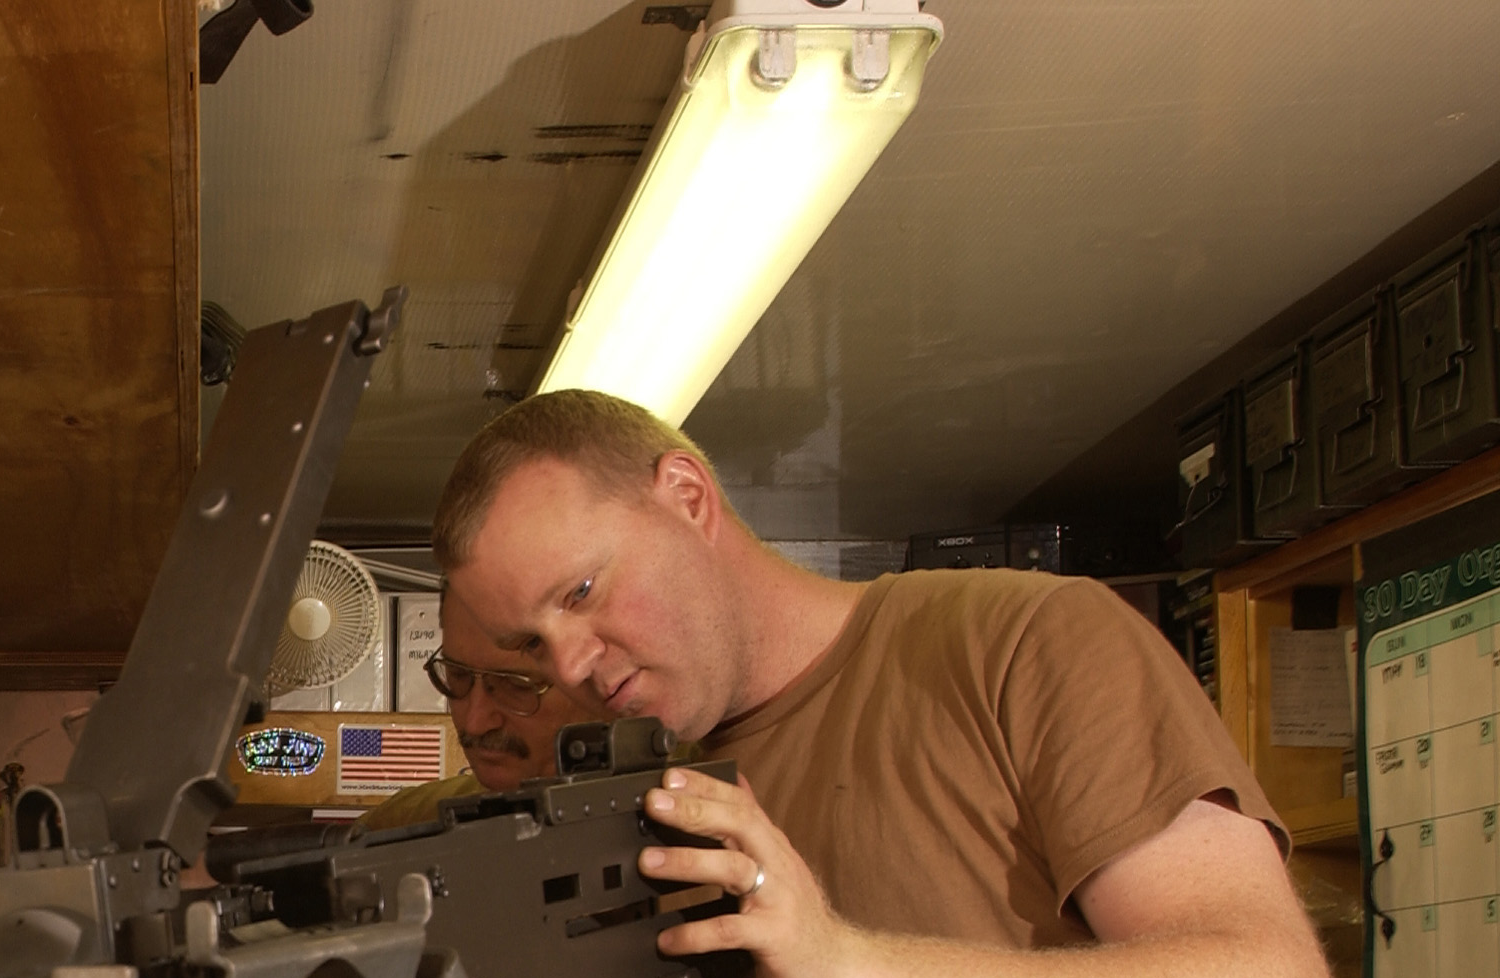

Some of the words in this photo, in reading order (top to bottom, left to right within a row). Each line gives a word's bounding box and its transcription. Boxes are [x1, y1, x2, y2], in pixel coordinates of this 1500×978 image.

[937, 536, 974, 547] XBOX
[1364, 578, 1396, 623] 30
[1399, 563, 1451, 609] Day
